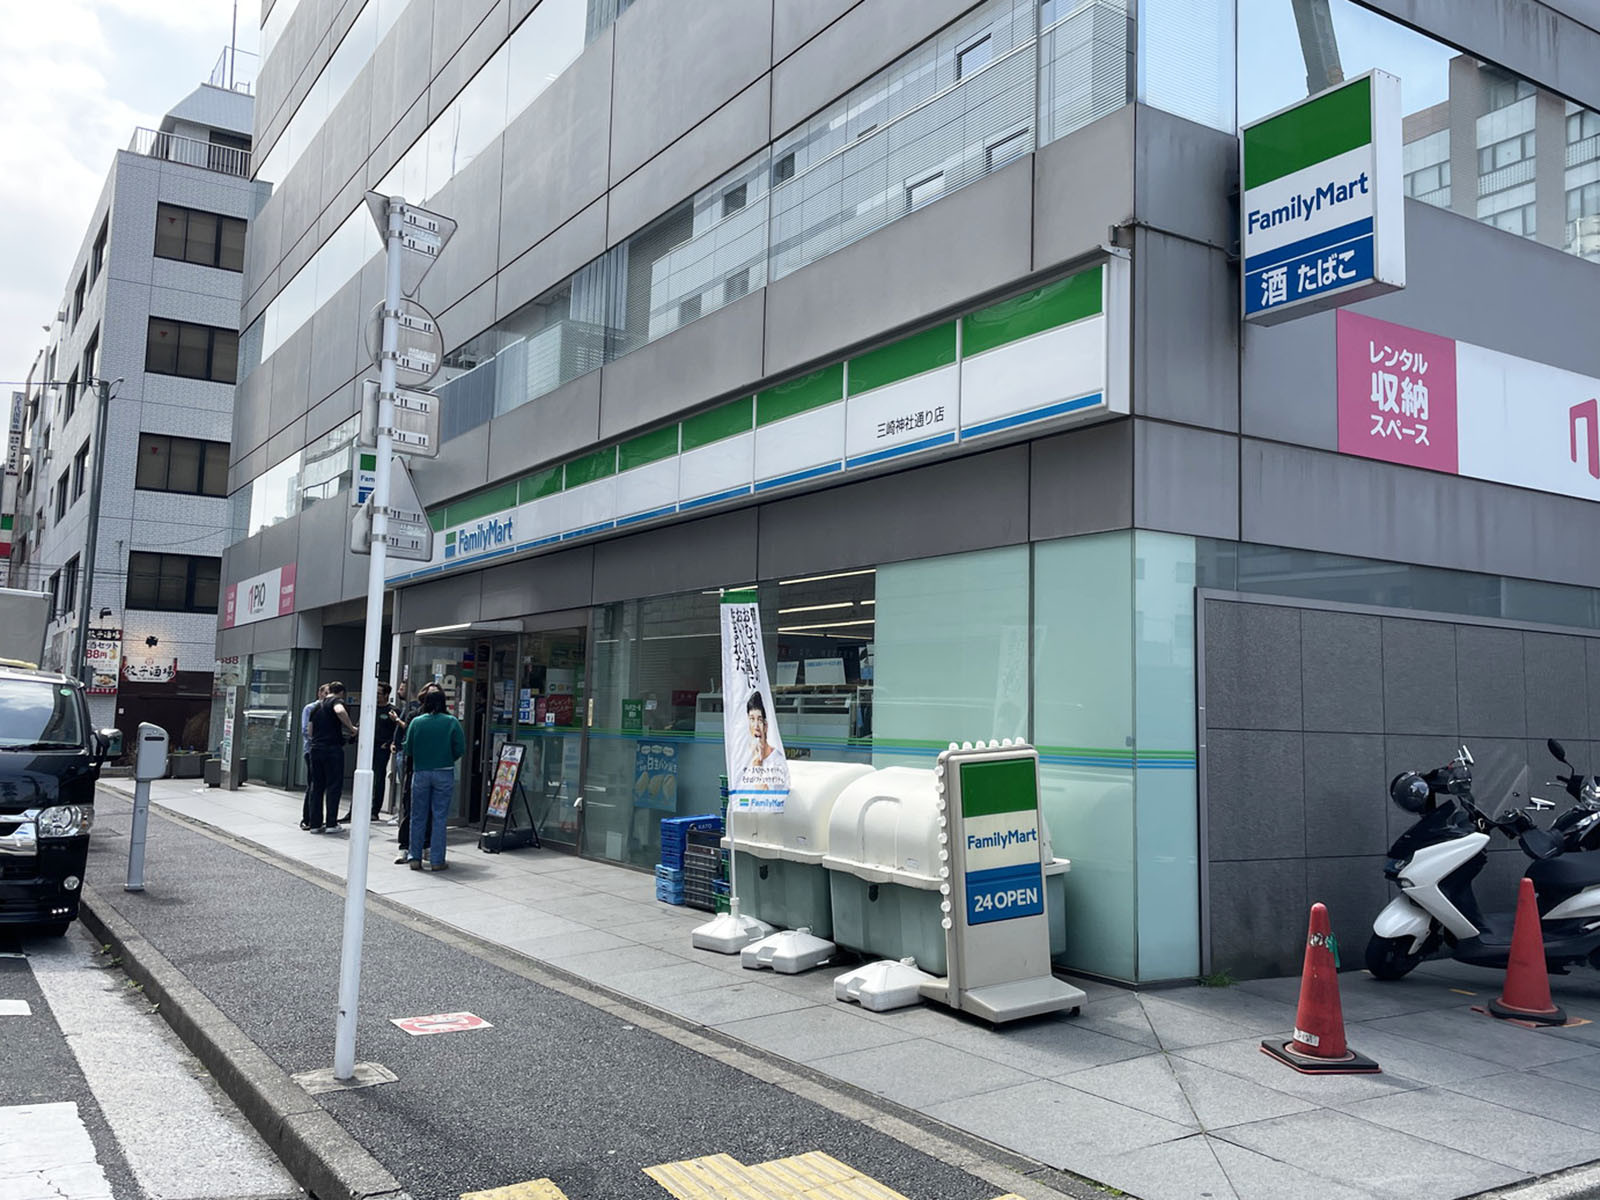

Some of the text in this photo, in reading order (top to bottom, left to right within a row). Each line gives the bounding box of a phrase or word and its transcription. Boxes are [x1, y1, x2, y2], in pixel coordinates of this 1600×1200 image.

[1248, 172, 1368, 235] FamilyMart
[1261, 250, 1356, 307] 酒 たばこ
[1370, 341, 1428, 374] レンタル
[1370, 370, 1429, 420] 収納
[1370, 414, 1430, 446] スペース
[458, 517, 513, 554] FamilyMart
[124, 665, 175, 678] 餃子酒場
[967, 828, 1038, 850] FamilyMart
